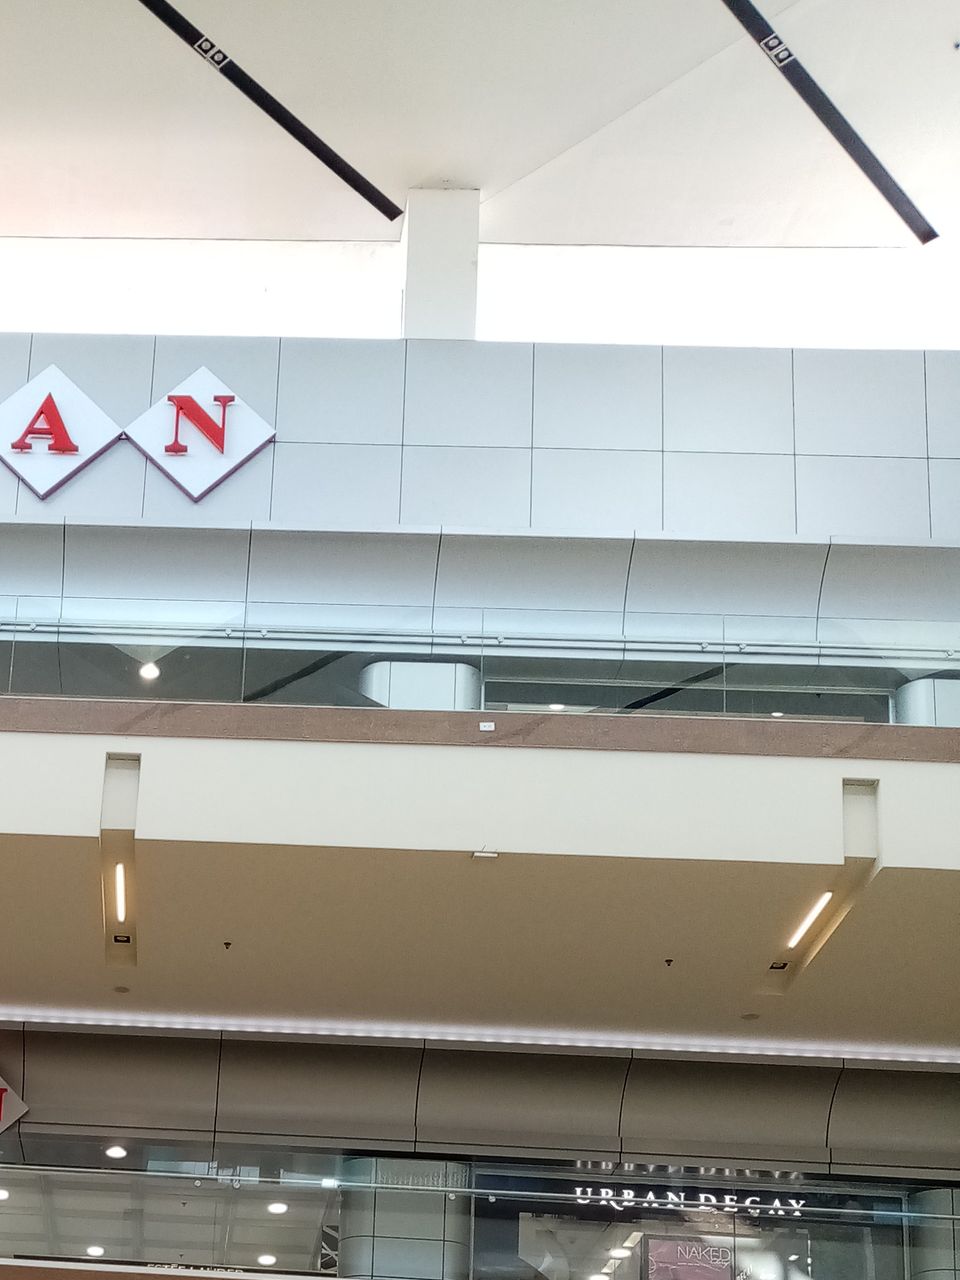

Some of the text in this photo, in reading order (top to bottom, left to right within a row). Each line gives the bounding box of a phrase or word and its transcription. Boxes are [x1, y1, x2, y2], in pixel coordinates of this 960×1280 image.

[574, 1187, 807, 1217] URBAN DECAY
[677, 1246, 731, 1261] NAKED
